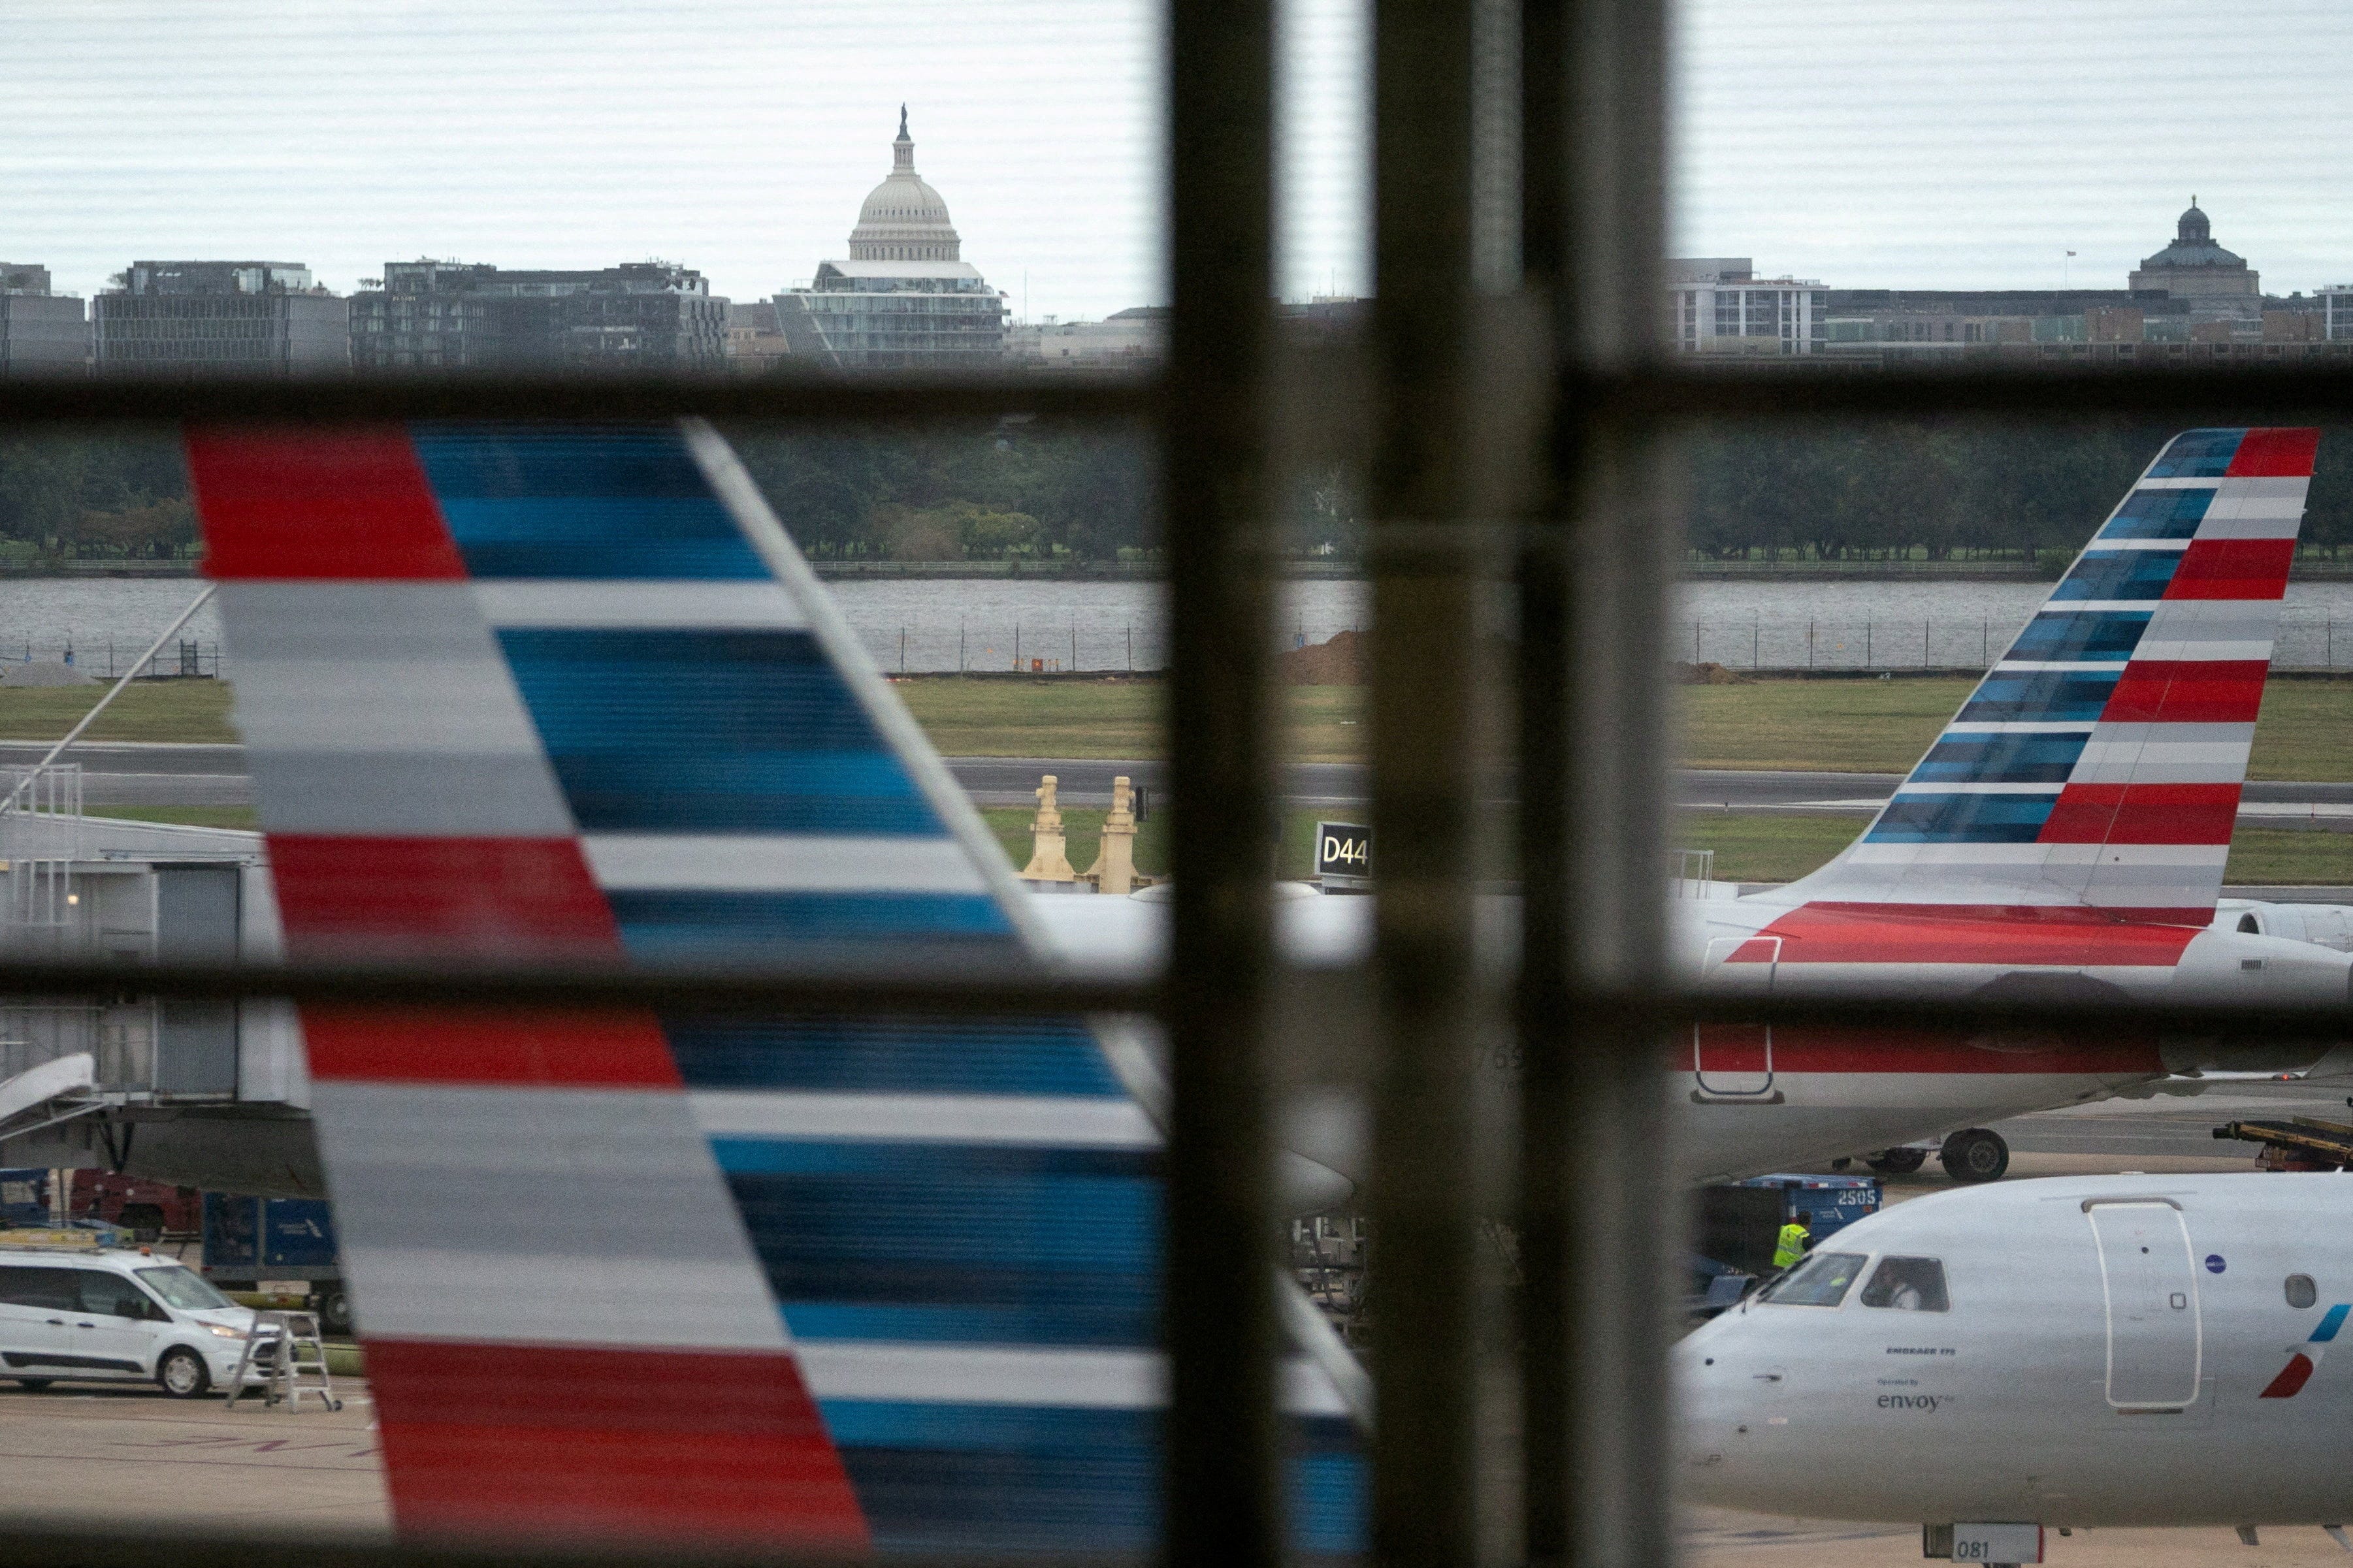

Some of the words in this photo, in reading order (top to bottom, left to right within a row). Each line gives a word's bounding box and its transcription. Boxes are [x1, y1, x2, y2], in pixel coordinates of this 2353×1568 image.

[1323, 836, 1368, 865] D44
[1838, 1189, 1875, 1206] 2505
[1877, 1394, 1942, 1413] envoy
[1957, 1541, 1988, 1558] 081
